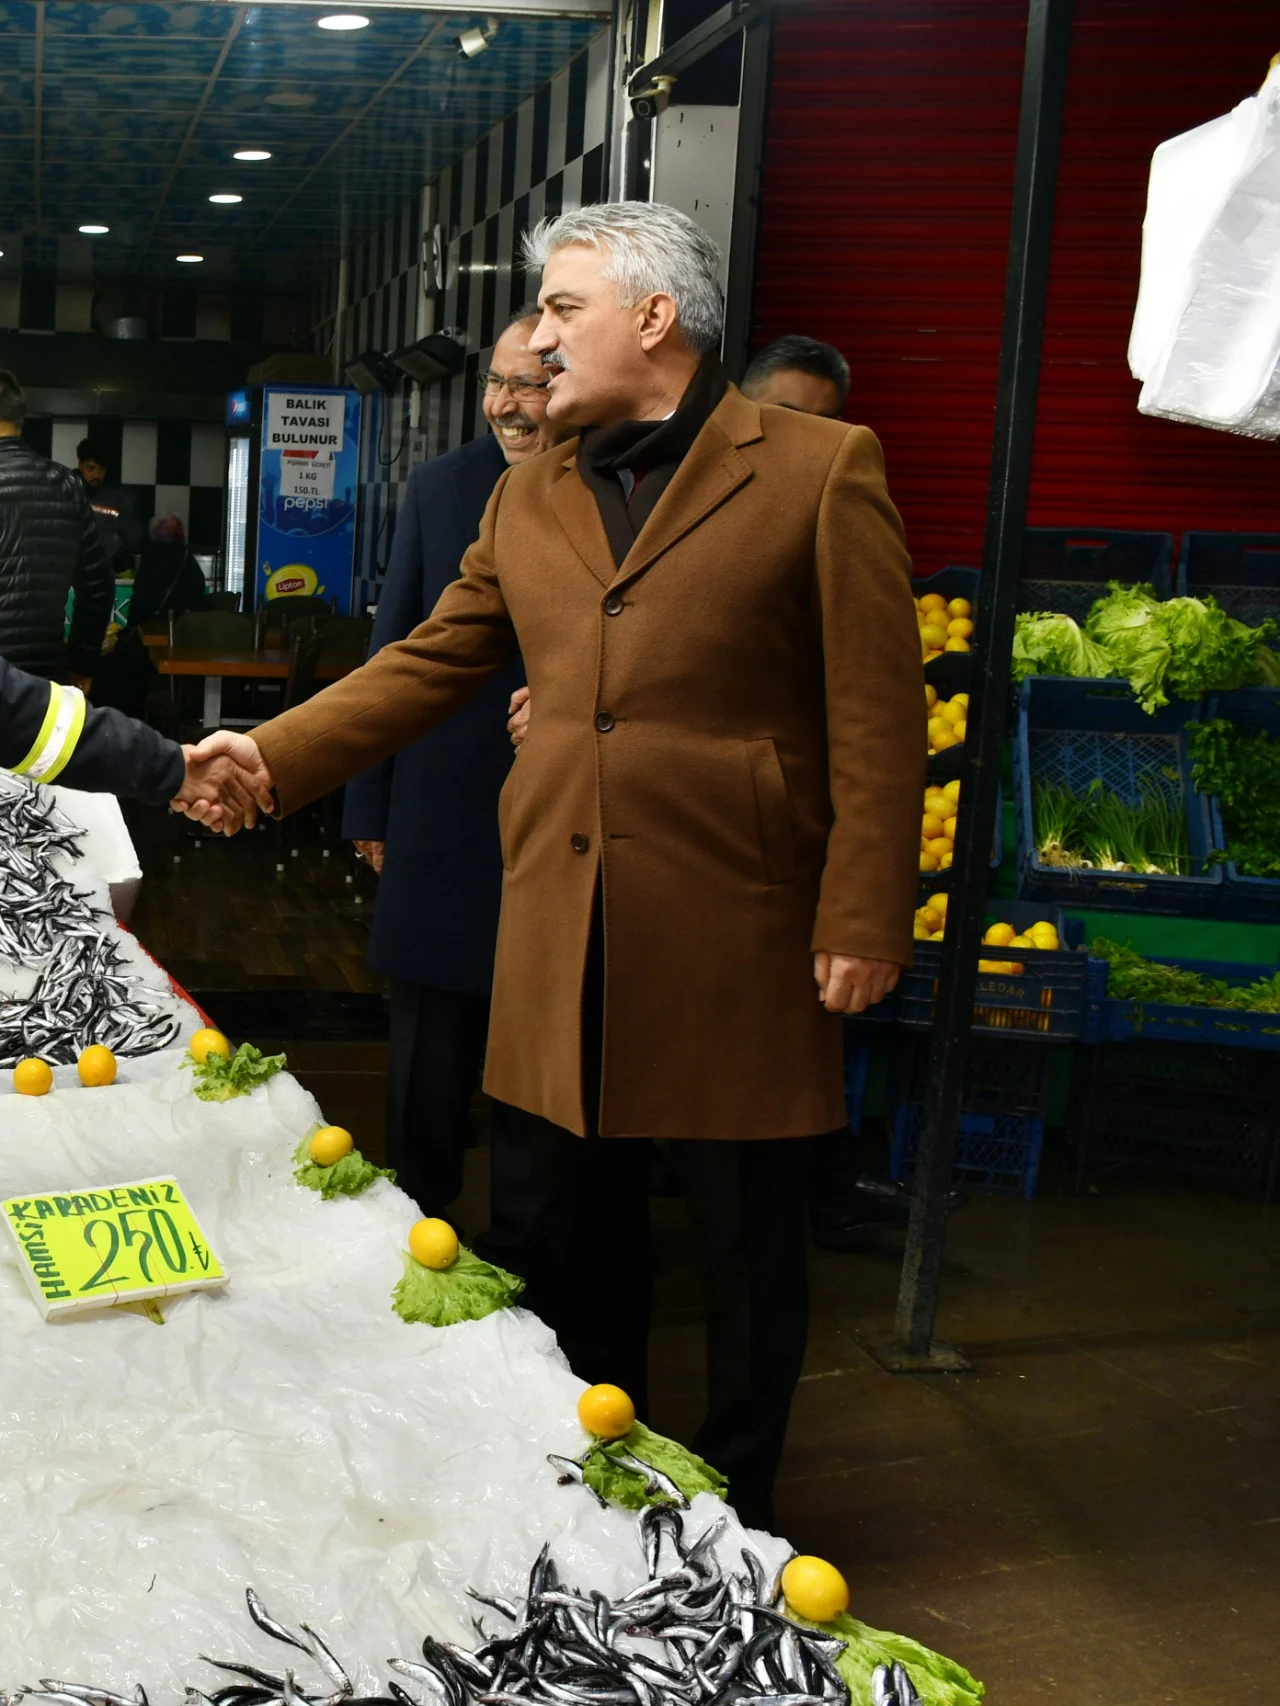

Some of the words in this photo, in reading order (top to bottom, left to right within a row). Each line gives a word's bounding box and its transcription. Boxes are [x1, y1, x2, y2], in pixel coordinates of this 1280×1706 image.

[286, 399, 327, 410] BALIK
[281, 416, 330, 428] TAVASI
[272, 433, 337, 445] BULUNUR
[299, 472, 304, 480] 1
[305, 472, 318, 481] KG
[278, 581, 304, 592] Lipton
[16, 1222, 72, 1300] HAMSİ
